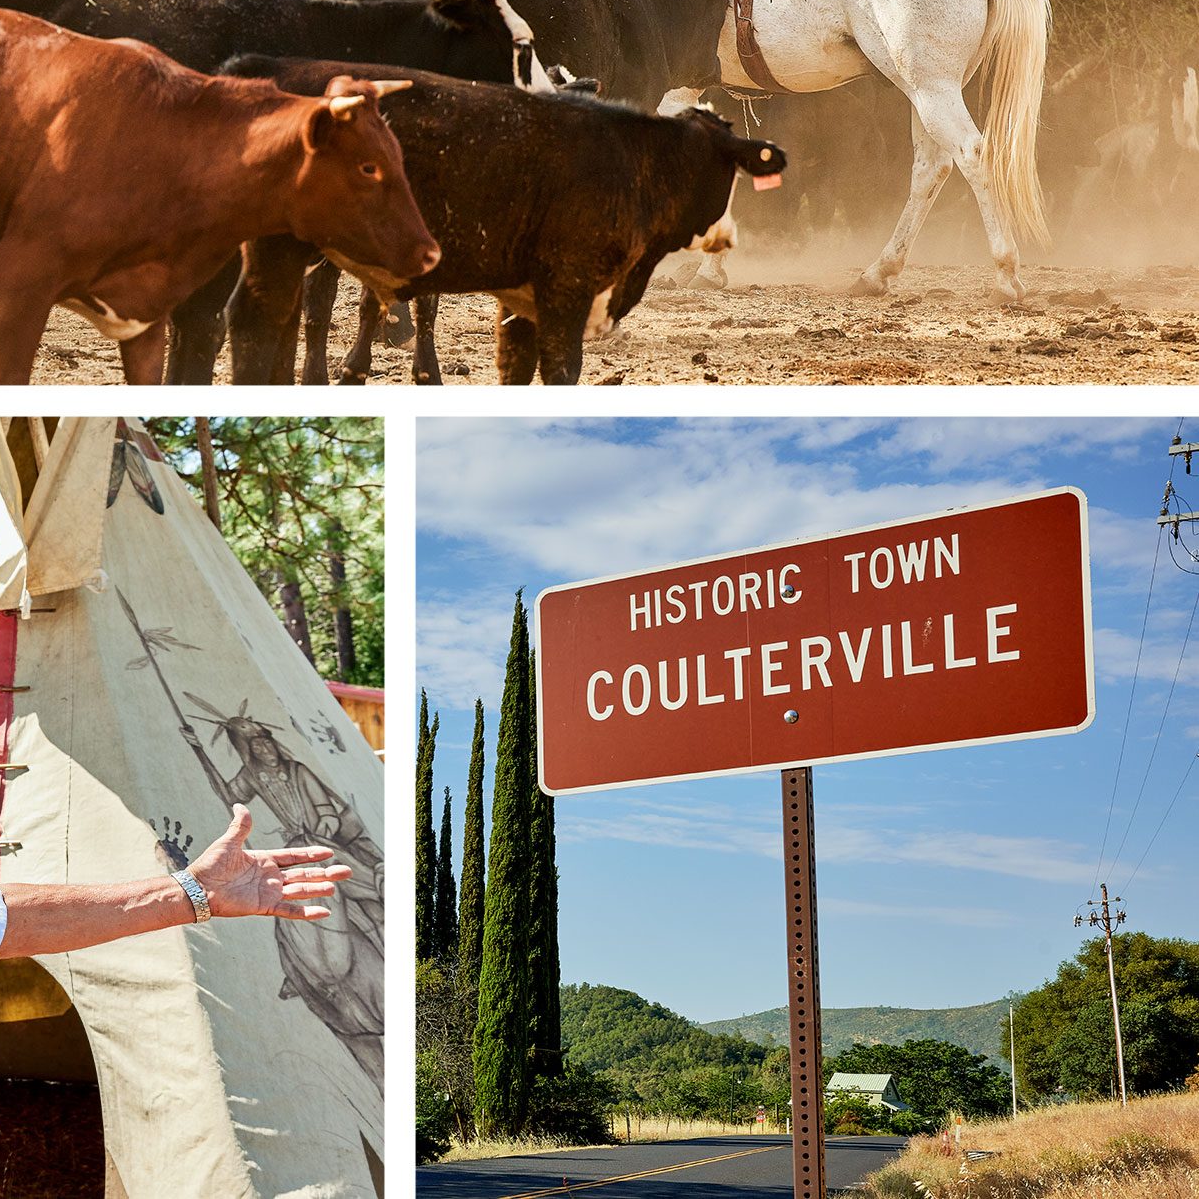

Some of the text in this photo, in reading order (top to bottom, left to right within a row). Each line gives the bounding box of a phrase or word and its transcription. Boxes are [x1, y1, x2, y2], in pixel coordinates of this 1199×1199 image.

[629, 533, 961, 632] HISTORIC TOWN
[586, 603, 1021, 722] COULTERVILLE
